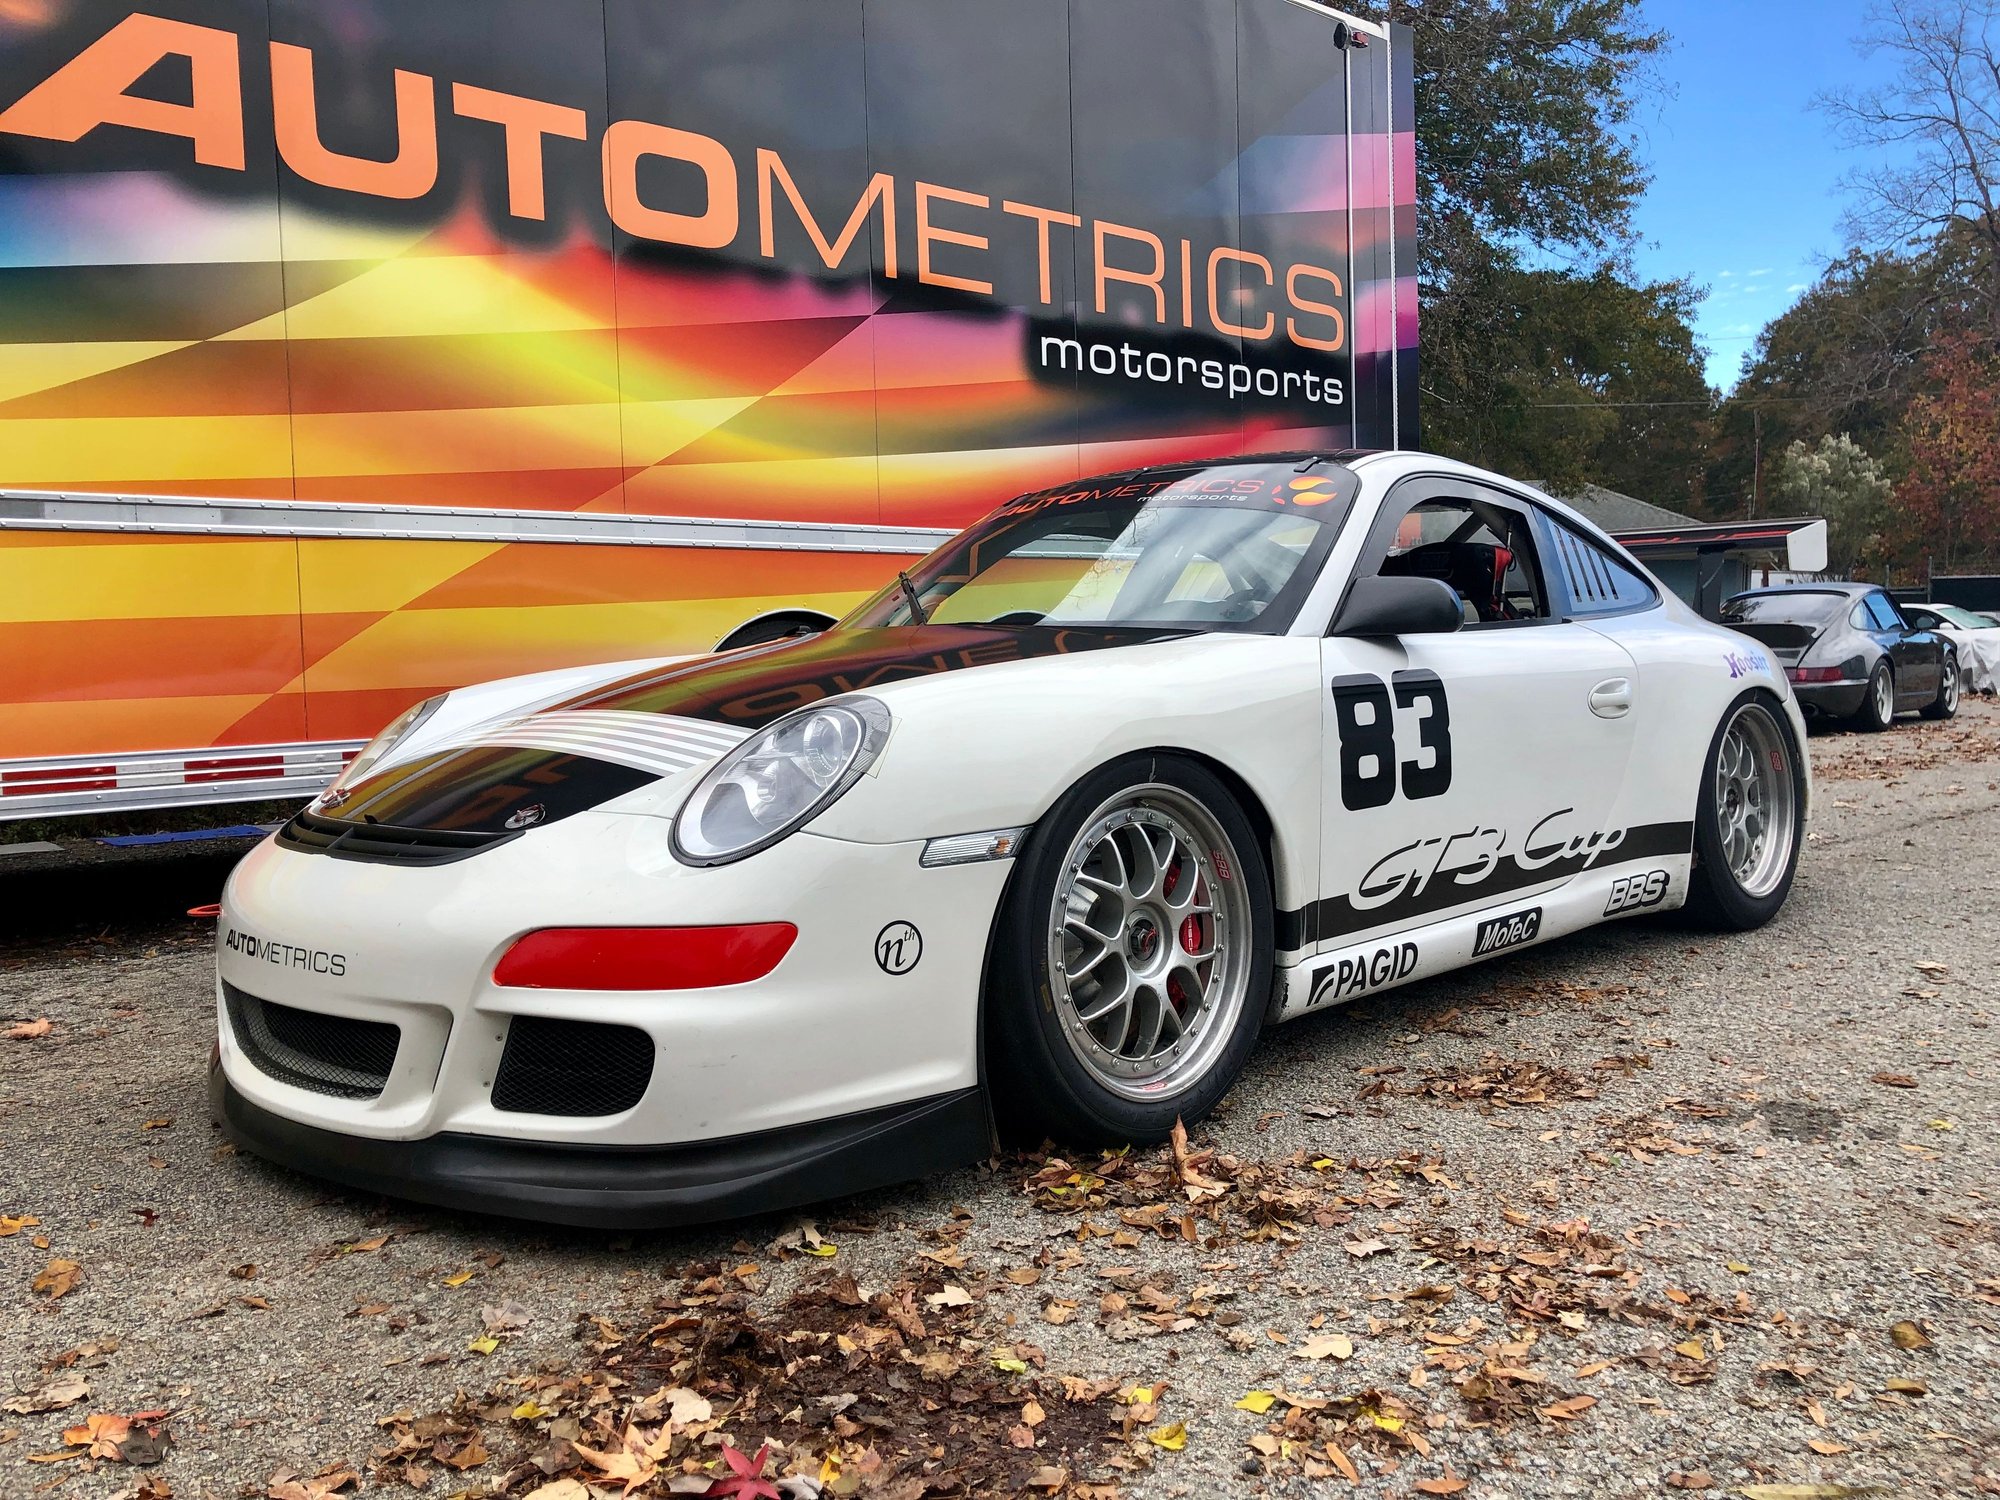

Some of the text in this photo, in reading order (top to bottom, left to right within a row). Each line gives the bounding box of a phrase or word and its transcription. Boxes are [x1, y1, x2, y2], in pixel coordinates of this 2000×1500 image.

[0, 12, 1345, 352] AUTOMETRICS
[1040, 336, 1343, 406] motorsports
[1003, 479, 1265, 517] AUTOMETRICS
[1136, 493, 1249, 503] motorsports
[1332, 668, 1452, 811] 83
[1348, 807, 1628, 911] GT3 Cup
[1603, 869, 1670, 917] BBS
[225, 928, 346, 977] AUTOMETRICS
[1477, 913, 1538, 954] MoTeC
[1333, 942, 1419, 998] PAGID
